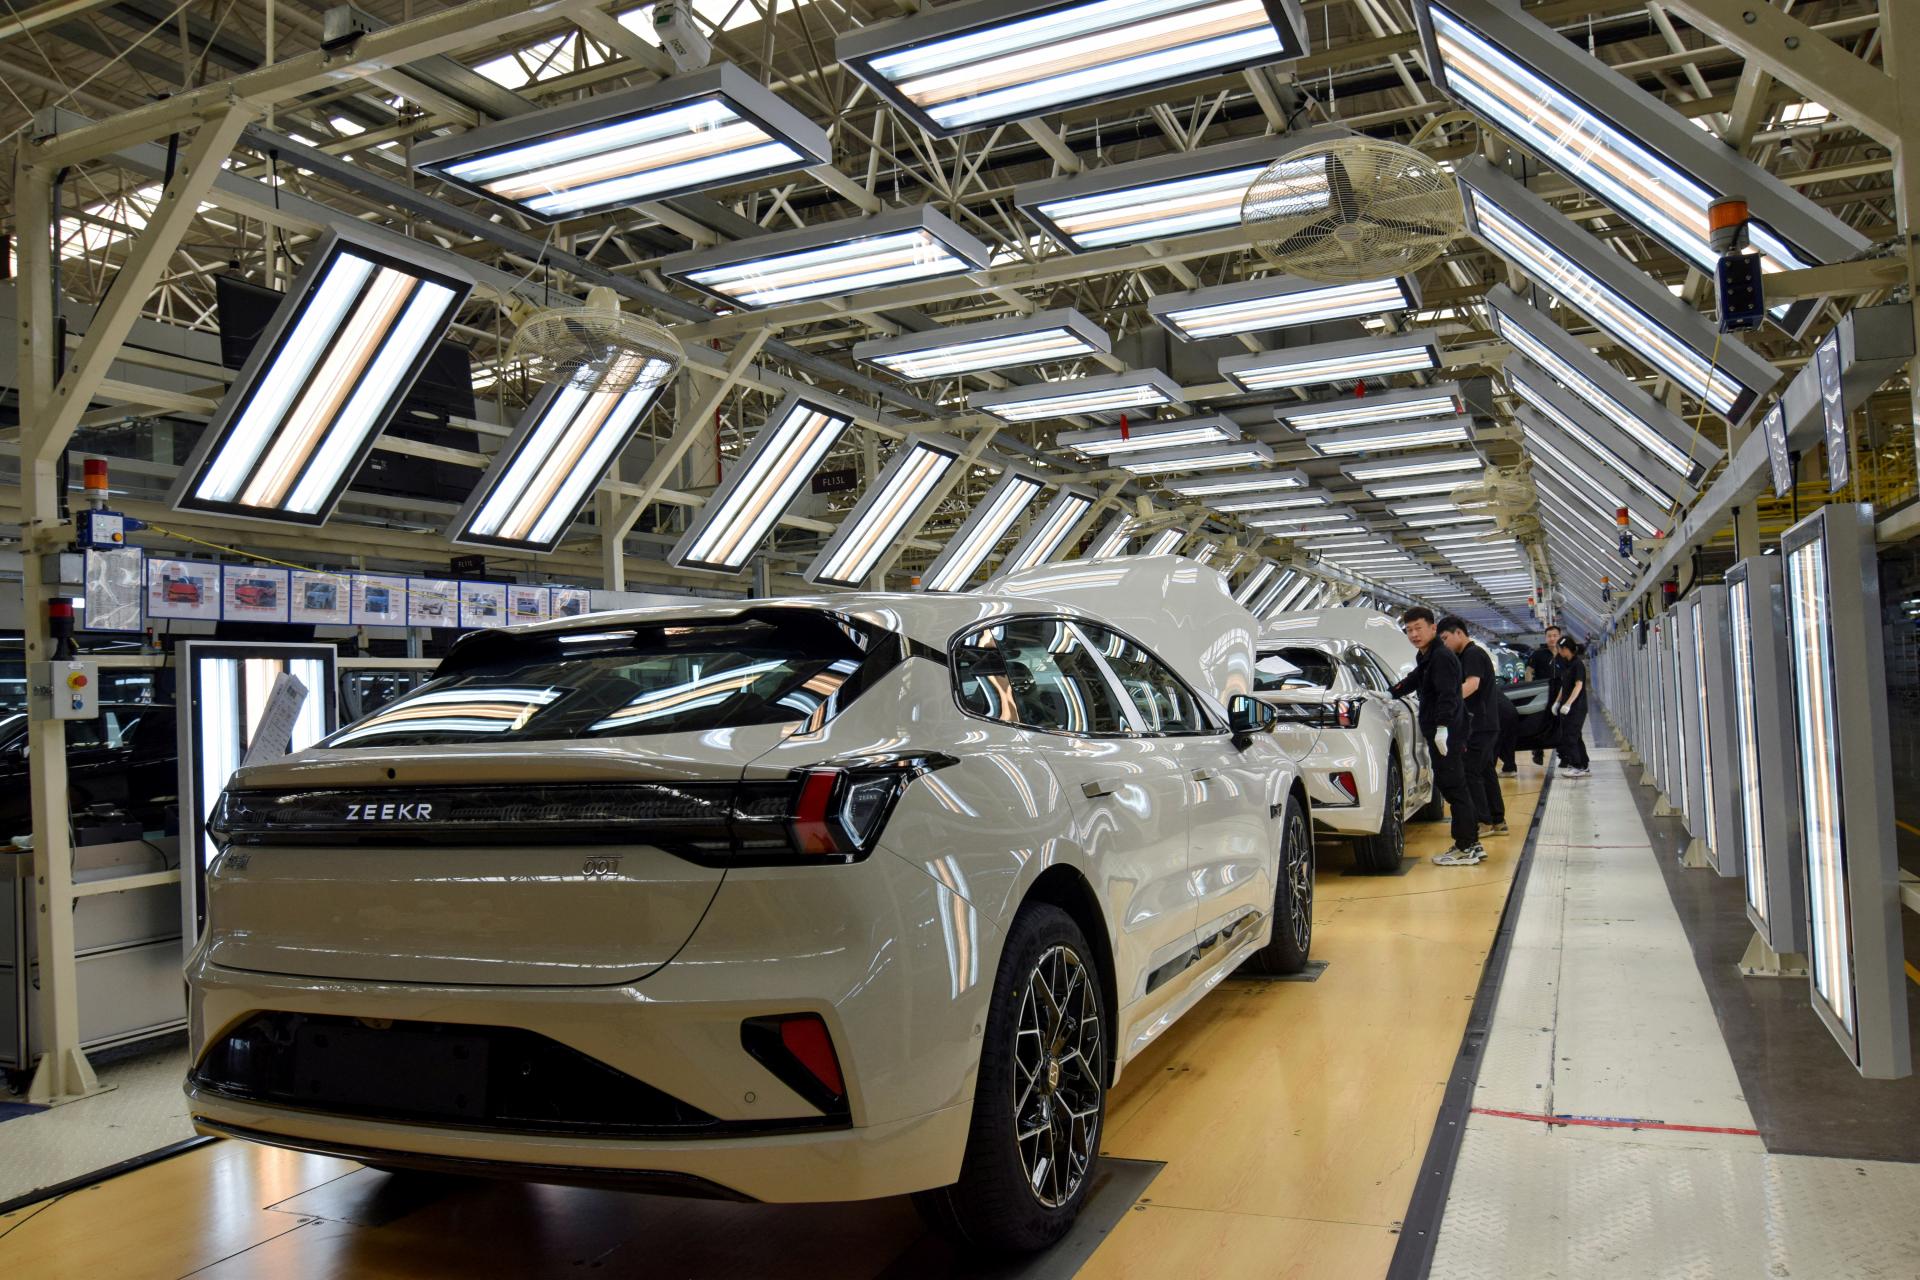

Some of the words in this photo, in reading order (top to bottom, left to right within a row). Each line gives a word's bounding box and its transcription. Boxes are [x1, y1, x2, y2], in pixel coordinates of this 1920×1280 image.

[822, 476, 846, 487] FL13L
[346, 803, 433, 820] ZEEKR
[582, 859, 620, 875] 001
